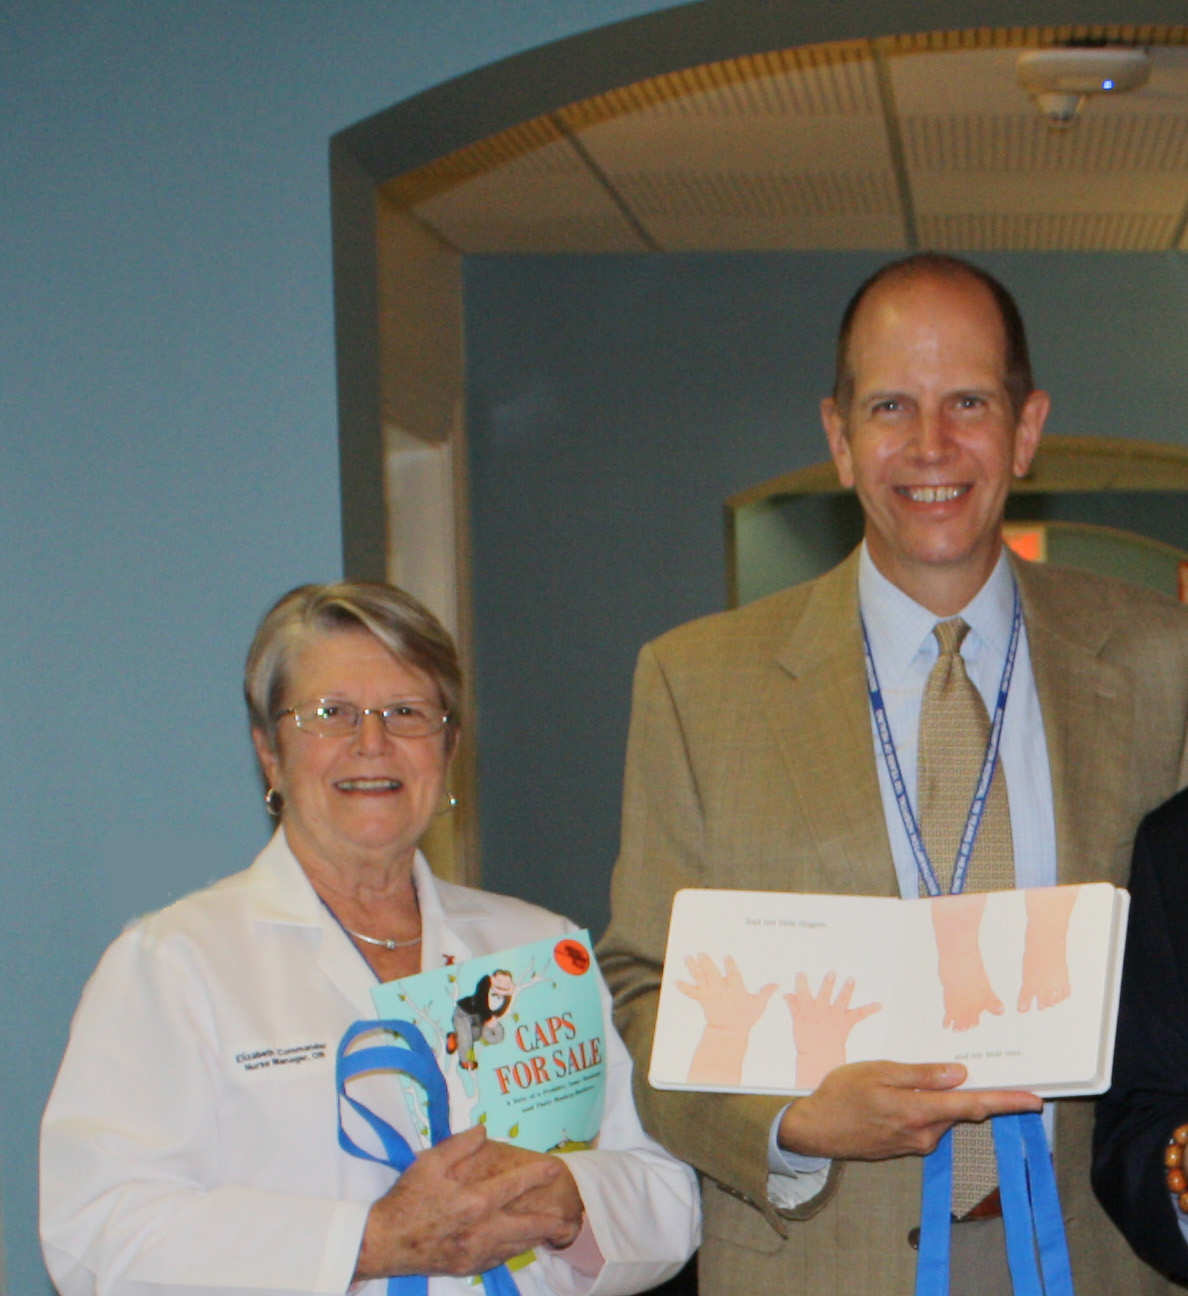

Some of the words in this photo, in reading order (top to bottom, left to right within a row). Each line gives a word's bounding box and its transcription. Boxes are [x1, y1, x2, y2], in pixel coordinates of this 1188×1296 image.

[514, 1011, 578, 1054] CAPS
[236, 1049, 275, 1063] Elizabeth
[494, 1058, 551, 1096] FOR
[553, 1037, 602, 1081] SALE
